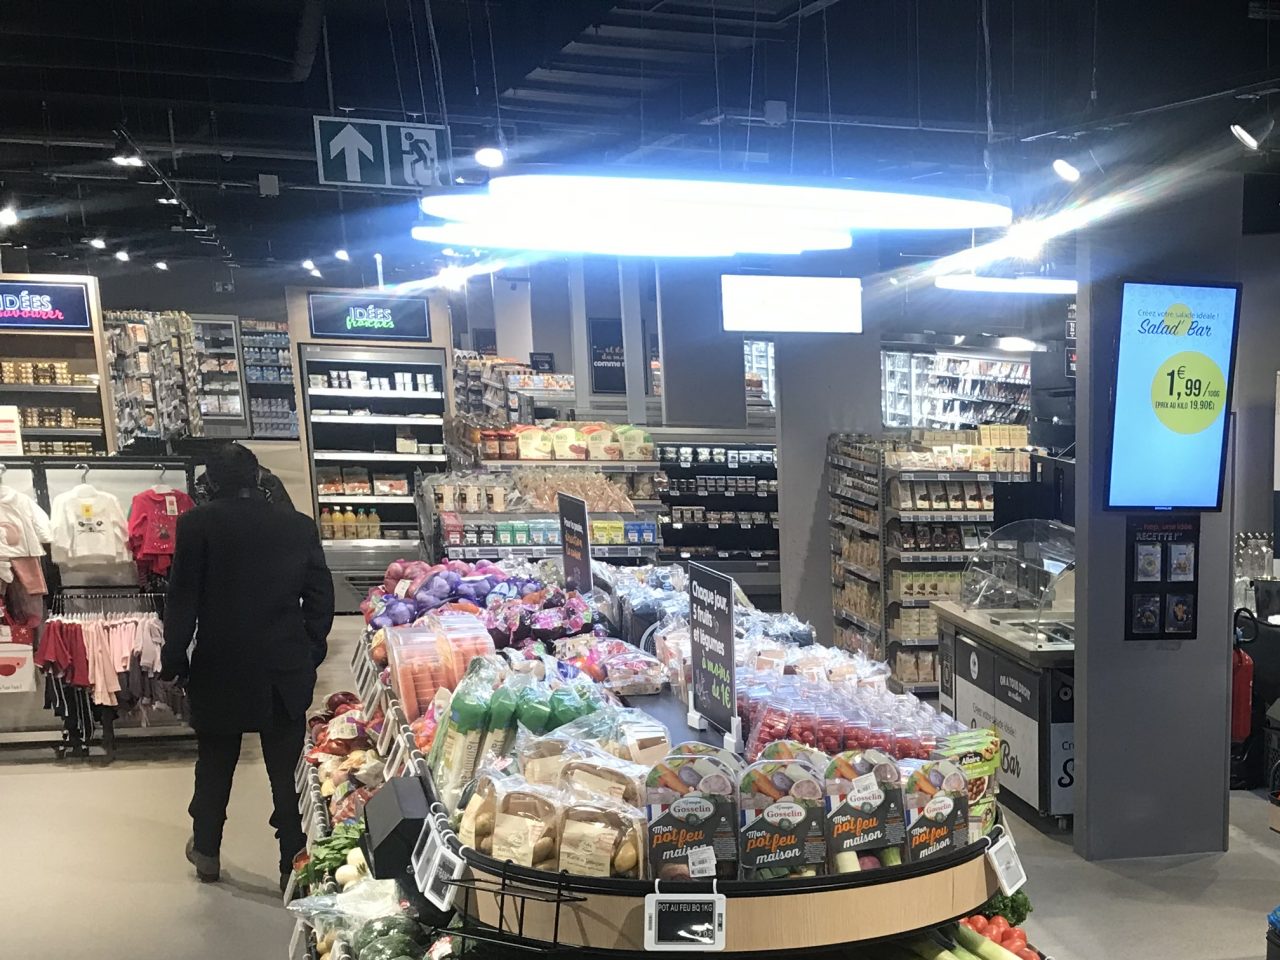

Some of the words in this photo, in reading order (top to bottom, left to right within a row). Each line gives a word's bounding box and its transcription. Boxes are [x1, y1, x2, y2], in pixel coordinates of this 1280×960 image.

[349, 305, 391, 321] IDÉES
[1187, 320, 1213, 337] Bar
[692, 580, 714, 606] Chaque
[714, 589, 728, 615] jour,
[697, 605, 712, 628] fruits
[693, 627, 699, 642] et
[699, 627, 725, 656] légumes
[707, 658, 730, 684] moins
[1000, 739, 1021, 779] Bar
[850, 793, 882, 802] Gosselin
[673, 805, 711, 813] Gosselin
[767, 810, 802, 818] Gosselin
[833, 815, 850, 825] Mon
[652, 825, 673, 834] Mon
[747, 830, 766, 839] Mon
[911, 826, 927, 835] Mon
[843, 830, 883, 848] maison
[756, 848, 801, 864] maison
[920, 838, 951, 859] maison
[692, 904, 701, 912] BQ
